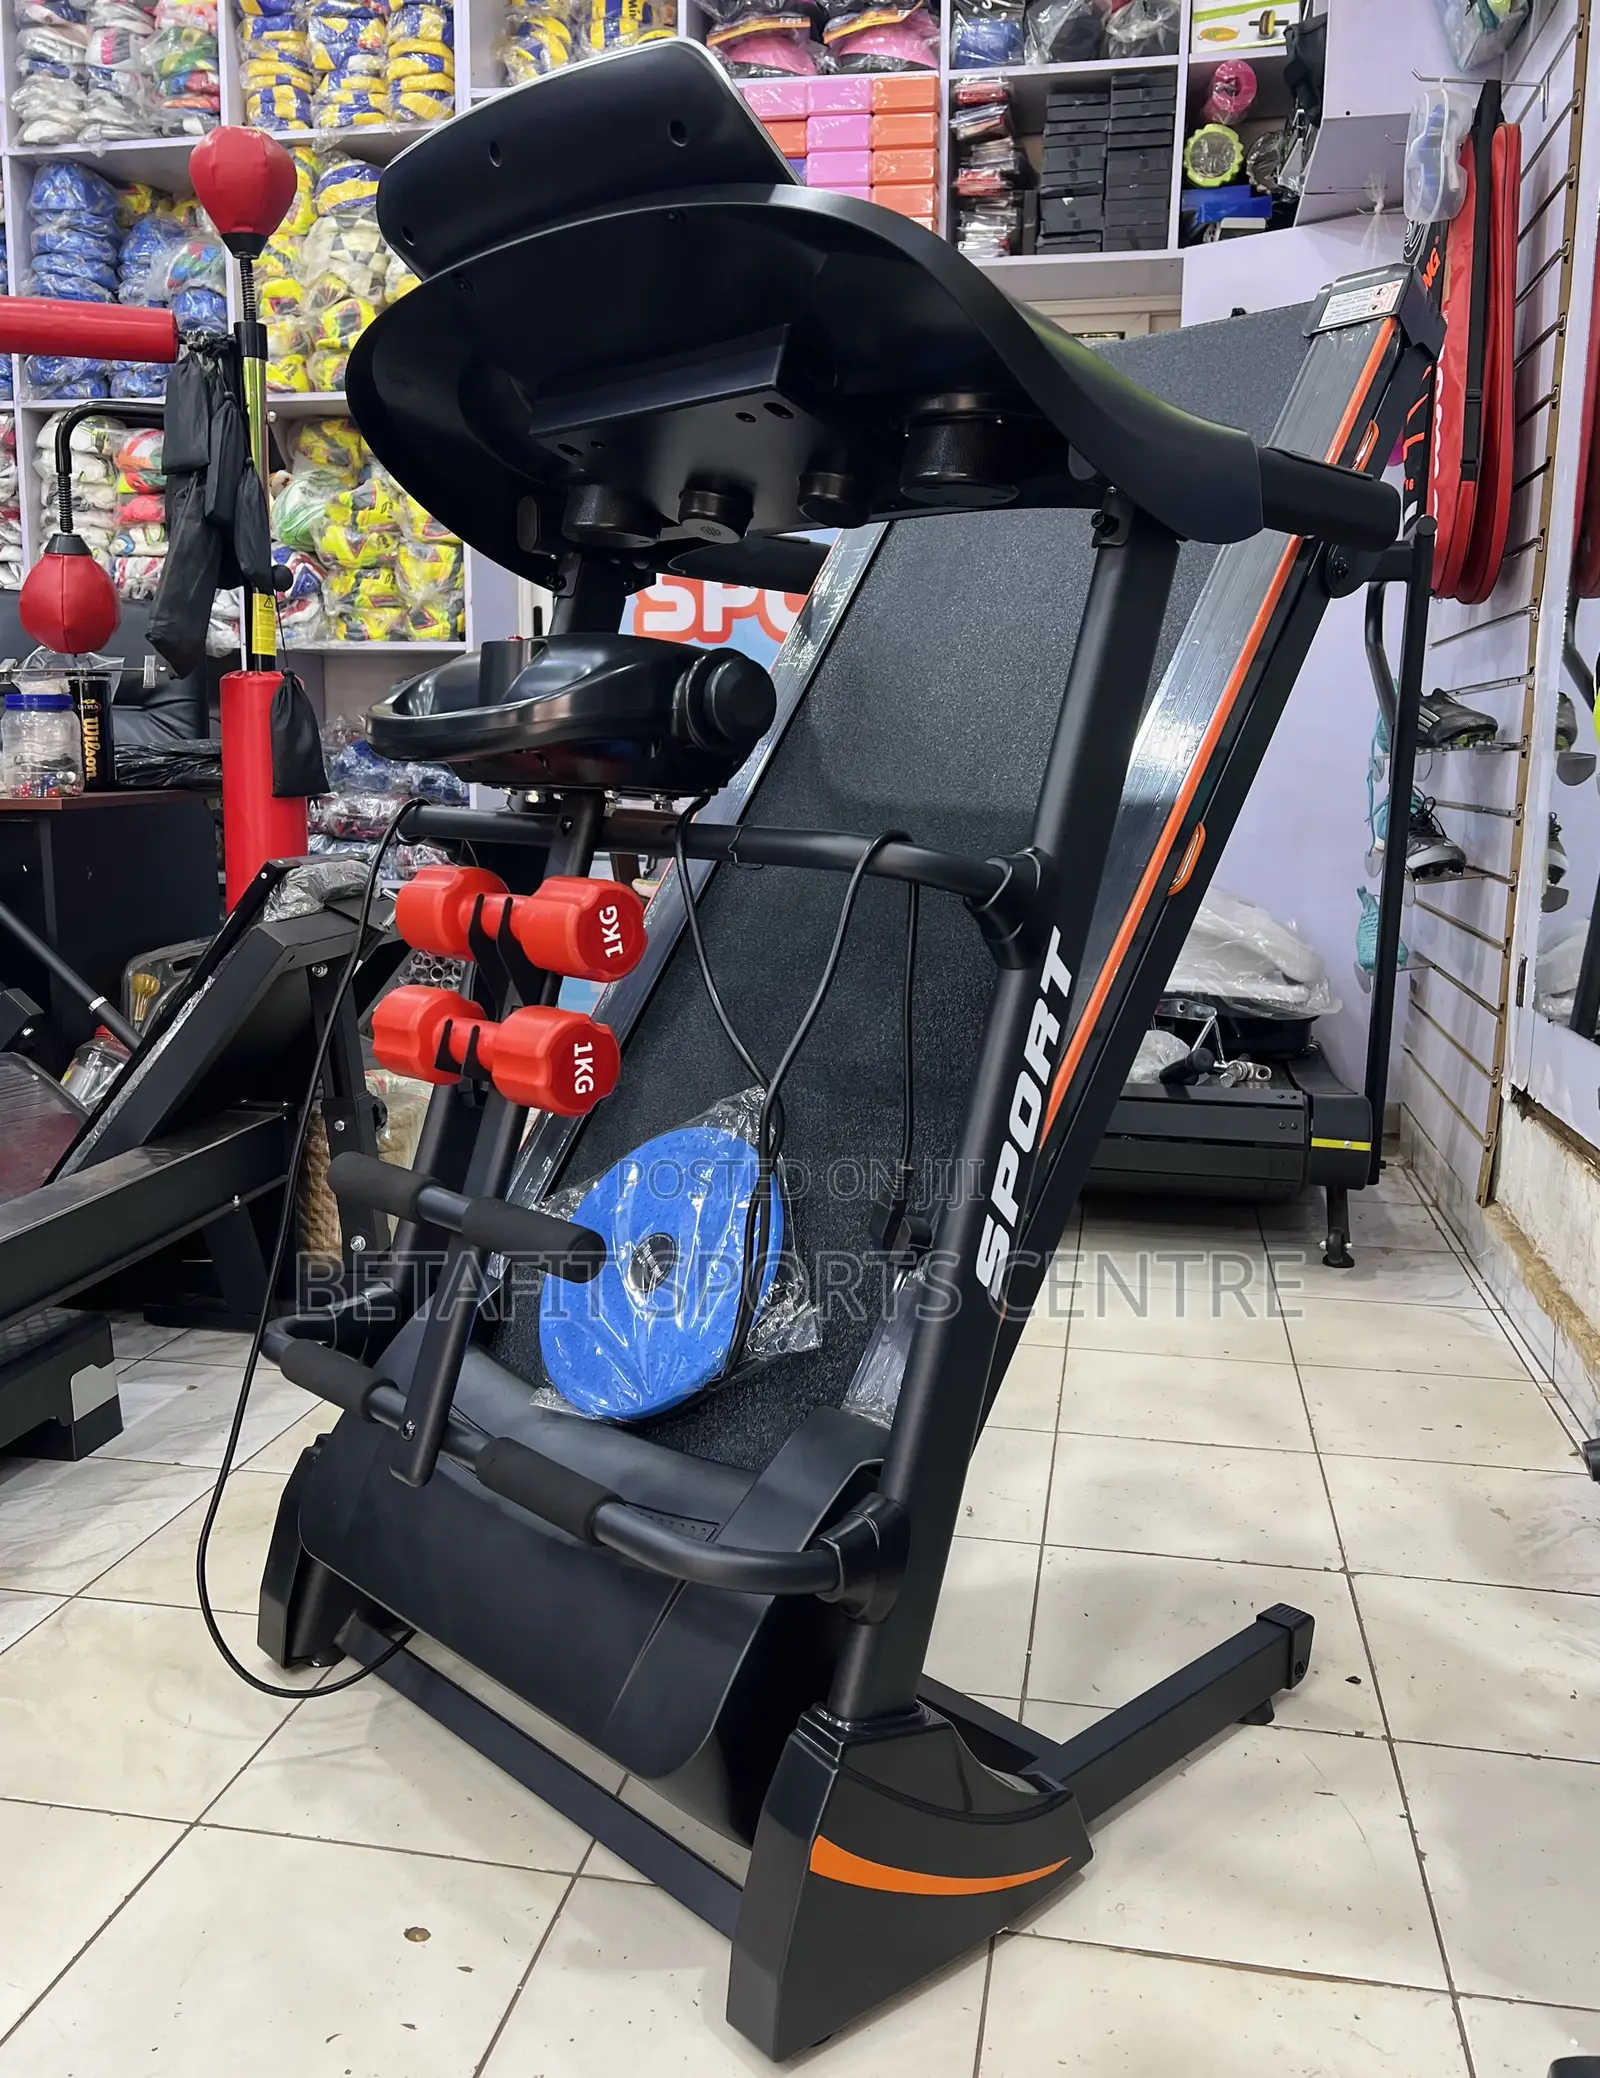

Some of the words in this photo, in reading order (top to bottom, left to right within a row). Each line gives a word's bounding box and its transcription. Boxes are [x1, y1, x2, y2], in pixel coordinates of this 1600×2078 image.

[83, 716, 101, 781] Wilson
[599, 904, 625, 959] 1KG
[573, 1041, 595, 1095] 1KG
[975, 924, 1073, 1302] SPORT
